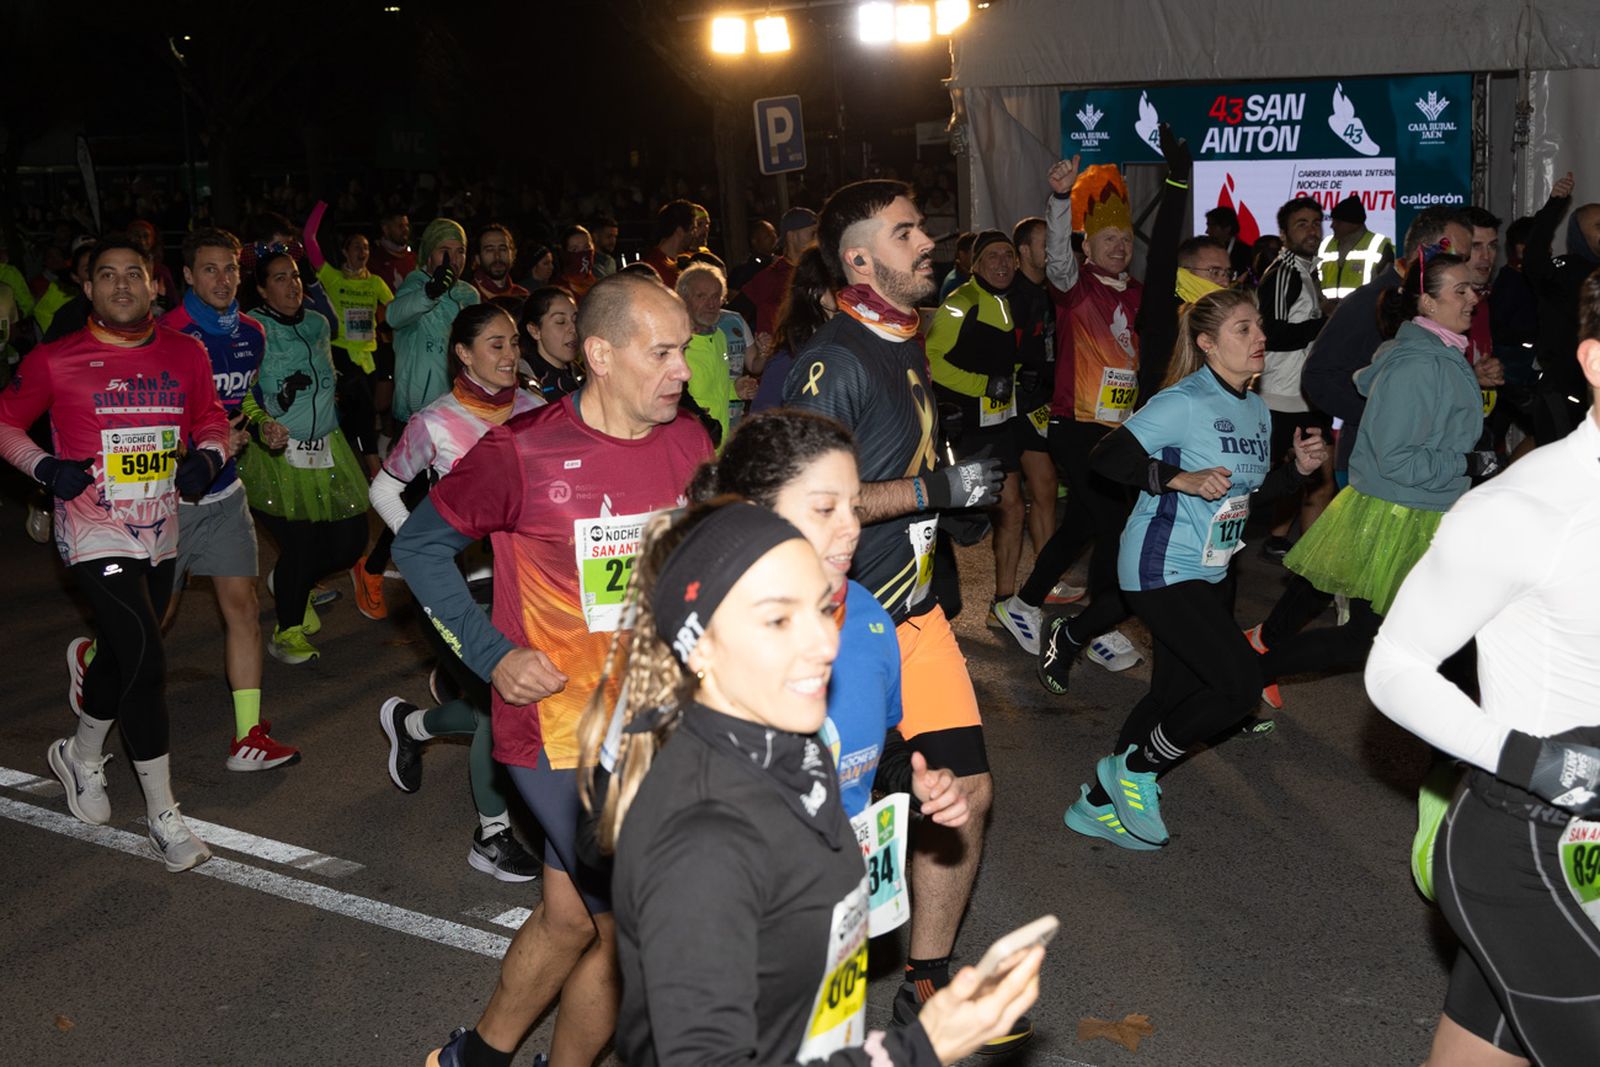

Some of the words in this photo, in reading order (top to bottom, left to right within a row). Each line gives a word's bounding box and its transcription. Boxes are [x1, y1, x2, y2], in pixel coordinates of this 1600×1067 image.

[1208, 95, 1244, 125] 43
[1245, 93, 1306, 122] SAN
[1343, 123, 1363, 144] 43
[1408, 123, 1428, 132] CAJA
[1429, 122, 1457, 131] RURAL
[766, 106, 794, 165] P
[1200, 117, 1300, 154] ANTÓN
[1298, 169, 1332, 178] CARRERA
[1332, 169, 1362, 177] URBANA
[1296, 181, 1329, 190] NOCHE
[1330, 180, 1343, 189] DE
[1400, 192, 1464, 205] calderón
[127, 378, 158, 391] SAN
[147, 434, 156, 443] DE
[112, 445, 129, 454] SAN
[121, 451, 168, 476] 5941
[605, 527, 640, 541] NOCHE
[592, 545, 616, 558] SAN
[1568, 827, 1588, 842] SAN
